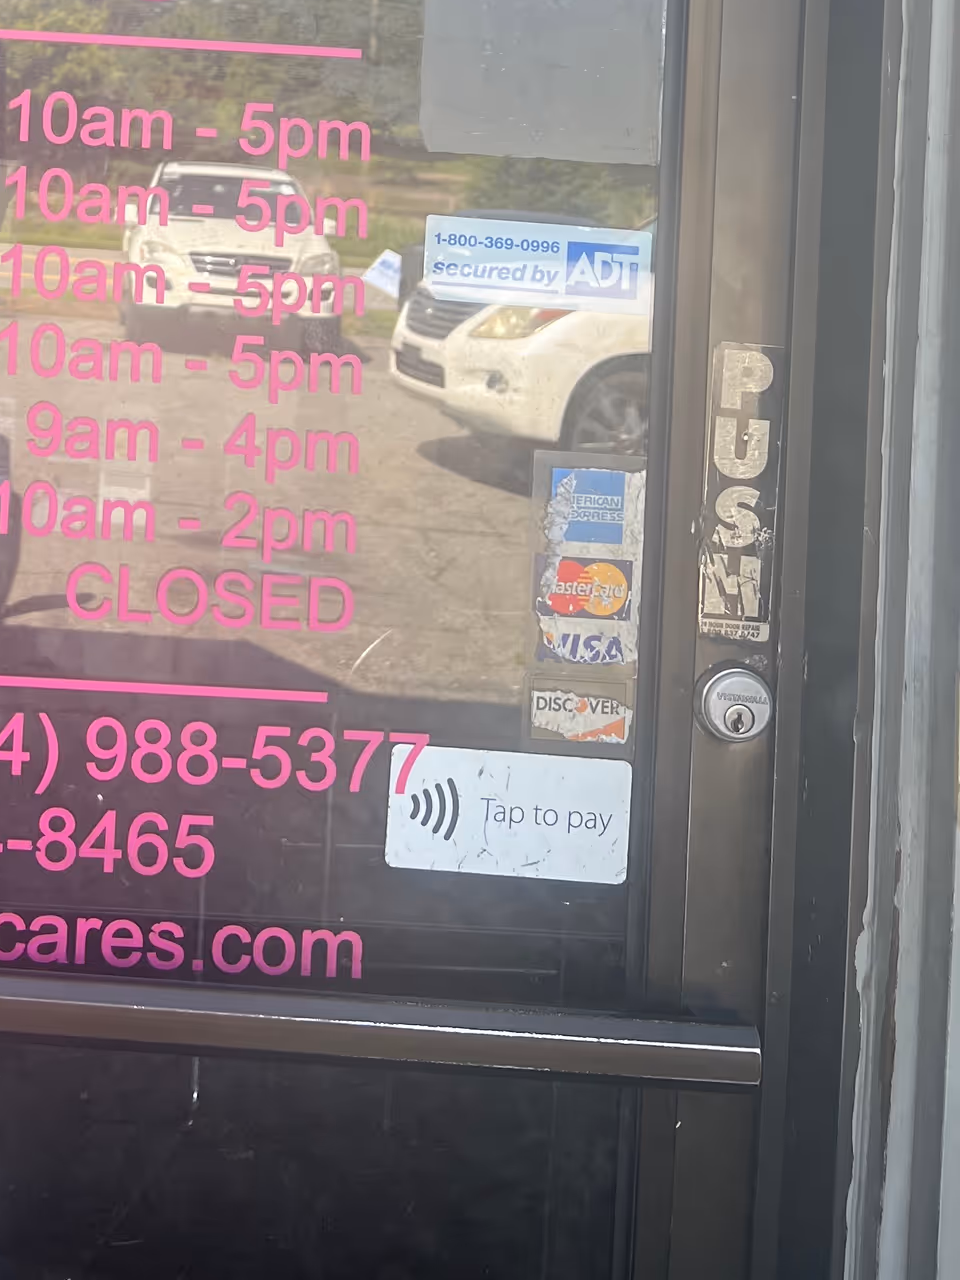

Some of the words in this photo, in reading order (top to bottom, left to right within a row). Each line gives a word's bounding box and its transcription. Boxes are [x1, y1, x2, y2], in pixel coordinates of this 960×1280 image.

[7, 88, 173, 151] 10am
[195, 127, 218, 138] -
[238, 102, 372, 170] 5pm
[4, 165, 170, 227] 10am
[192, 204, 215, 215] -
[234, 179, 369, 248] 5pm
[432, 261, 528, 282] secured
[530, 264, 560, 287] by
[434, 232, 561, 254] 1-800-369-0996
[565, 250, 639, 291] ADT
[0, 243, 166, 305] 10am
[188, 282, 211, 293] -
[232, 264, 366, 327] 5pm
[184, 360, 208, 371] -
[228, 335, 363, 405] 5pm
[26, 400, 160, 463] 9am
[181, 438, 205, 450] -
[222, 412, 360, 485] 4pm
[570, 494, 620, 508] ERICAN
[704, 348, 774, 619] PUSH
[178, 517, 202, 531] -
[220, 491, 358, 565] 2pm
[65, 562, 356, 633] CLOSED
[551, 580, 625, 598] asterCard
[84, 715, 431, 797] 988-5377
[480, 797, 524, 830] Tap
[533, 804, 559, 826] to
[567, 809, 613, 837] pay
